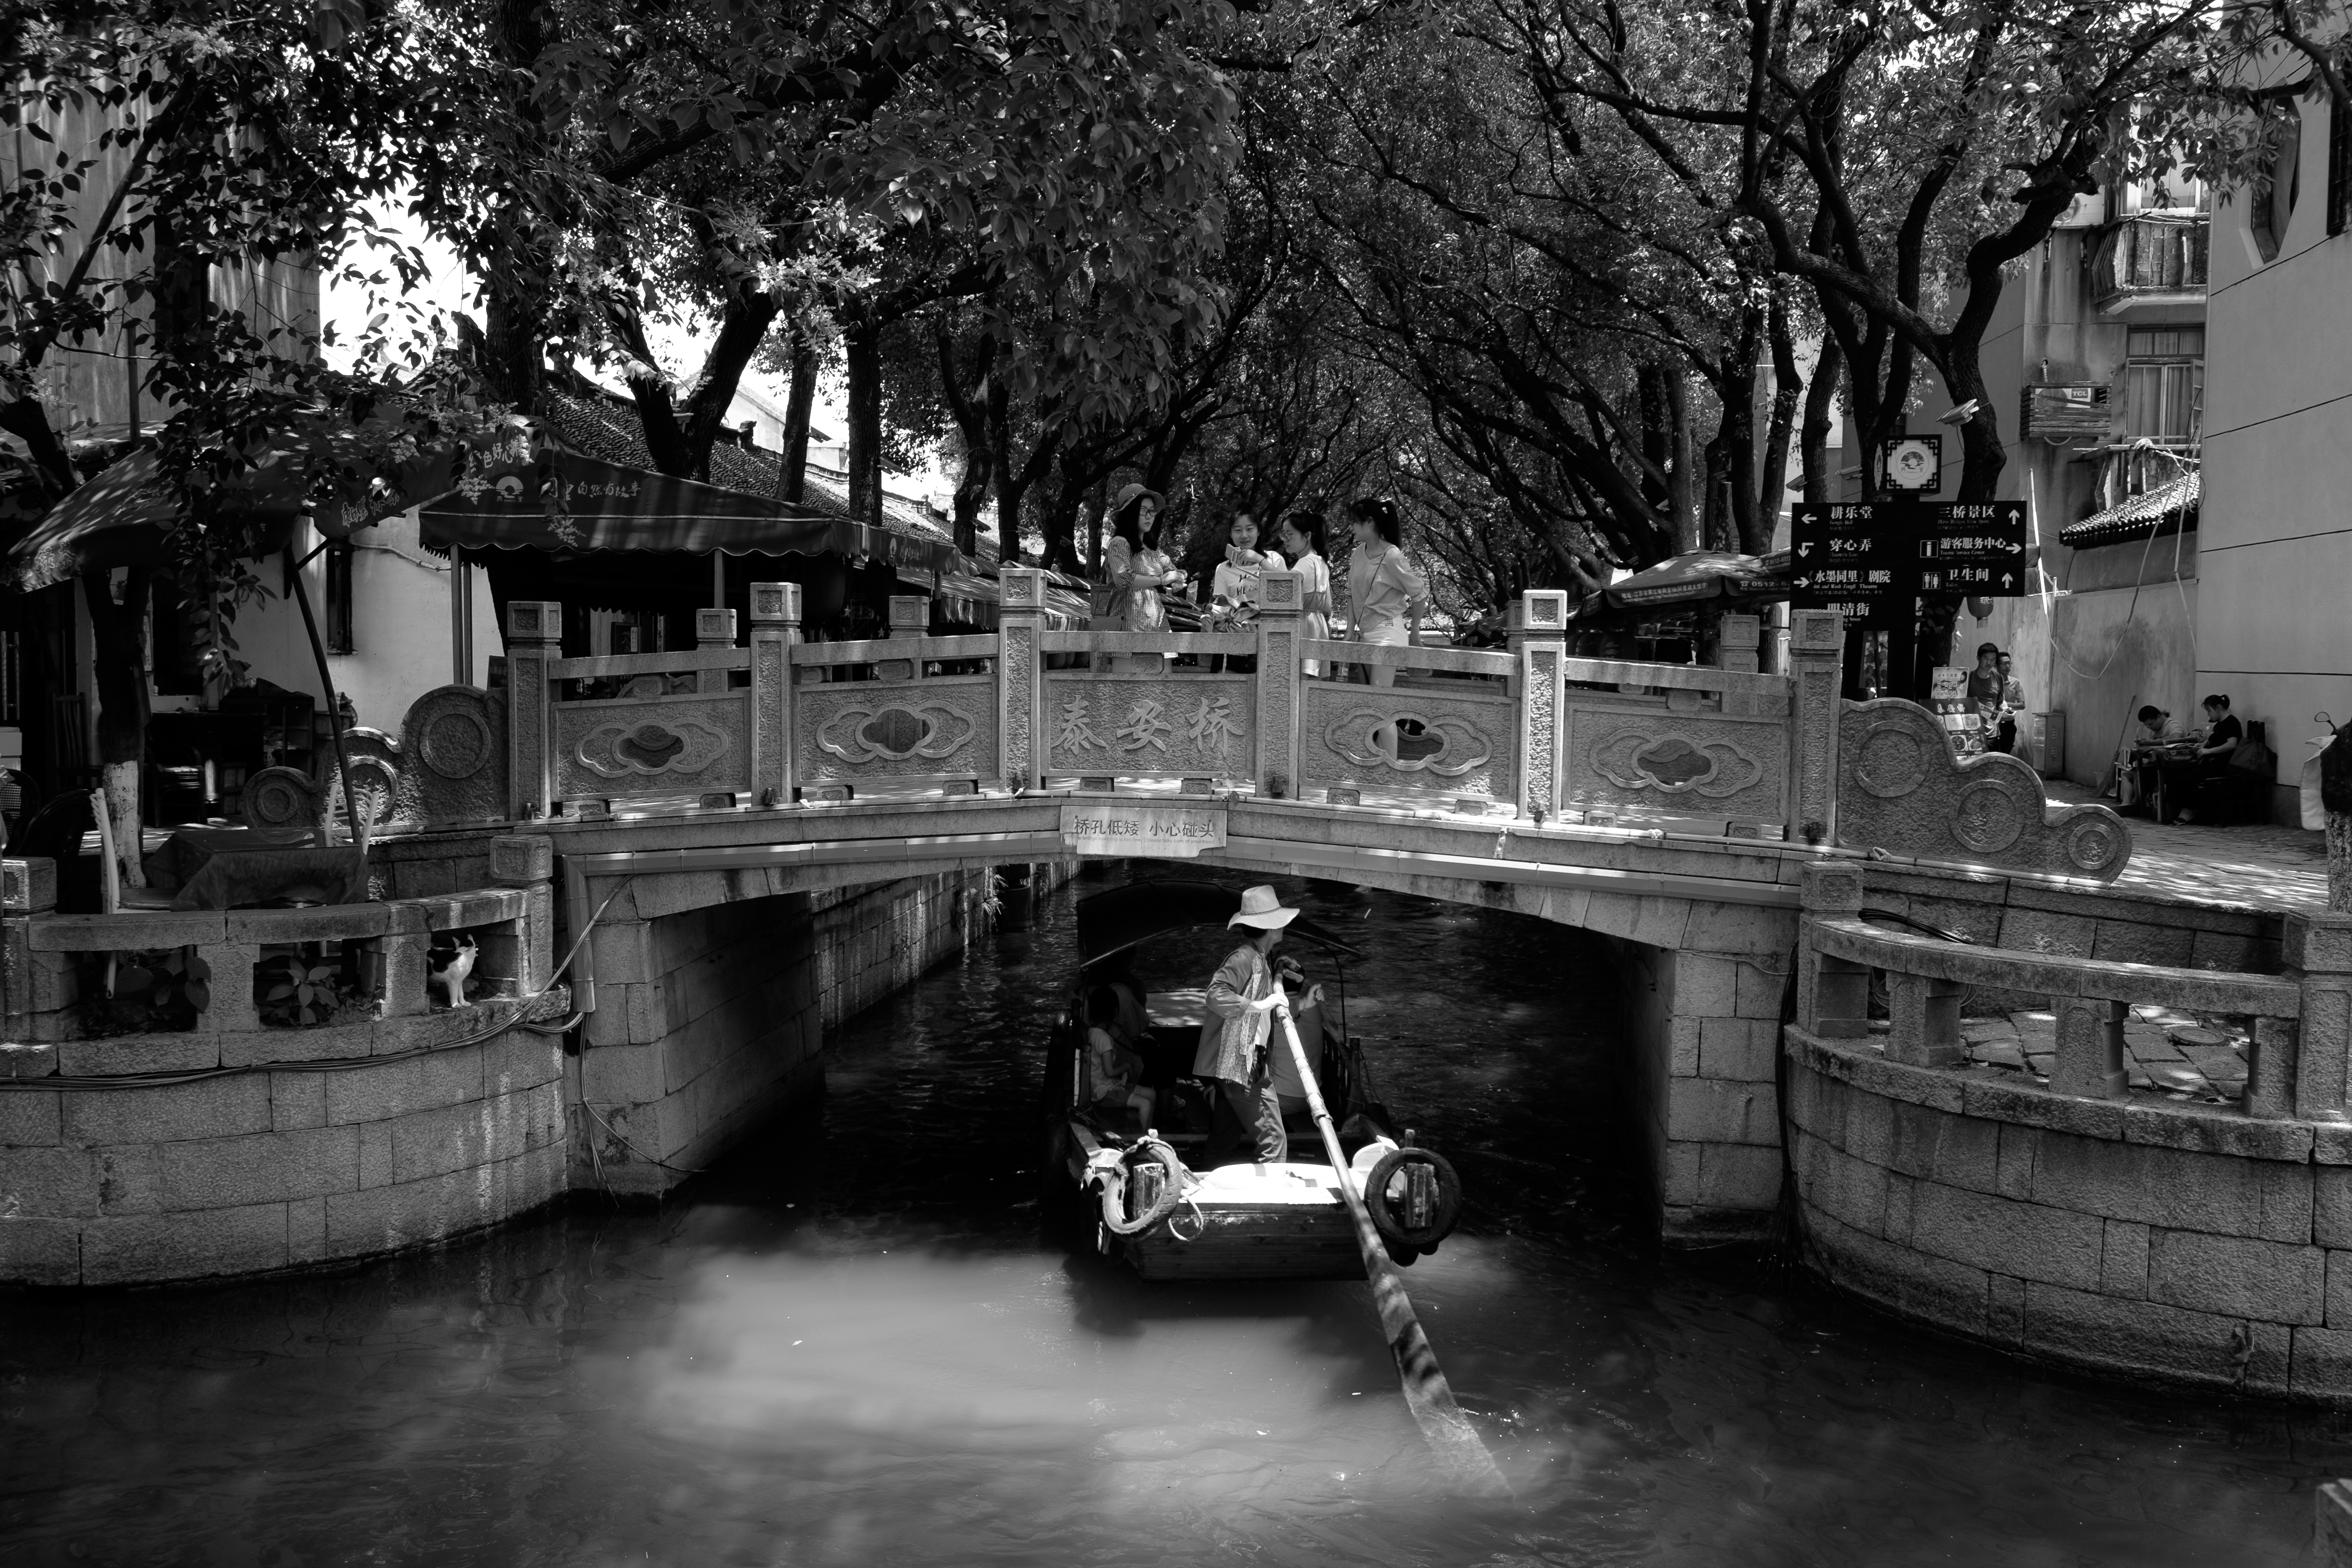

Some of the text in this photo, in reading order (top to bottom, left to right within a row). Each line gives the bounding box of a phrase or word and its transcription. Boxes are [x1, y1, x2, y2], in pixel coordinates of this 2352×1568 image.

[469, 441, 522, 474] 绿色好心
[1830, 506, 1873, 519] 耕乐堂
[1938, 505, 1995, 518] 三桥景区
[1829, 538, 1872, 551] 穿心弄
[1940, 537, 2006, 549] 游客服务中心
[1809, 570, 1891, 583] 《水墨同里》剧院
[1946, 568, 1989, 581] 卫生间
[1051, 694, 1245, 758] 泰安桥
[1074, 819, 1214, 838] 桥孔低矮 小心碰头
